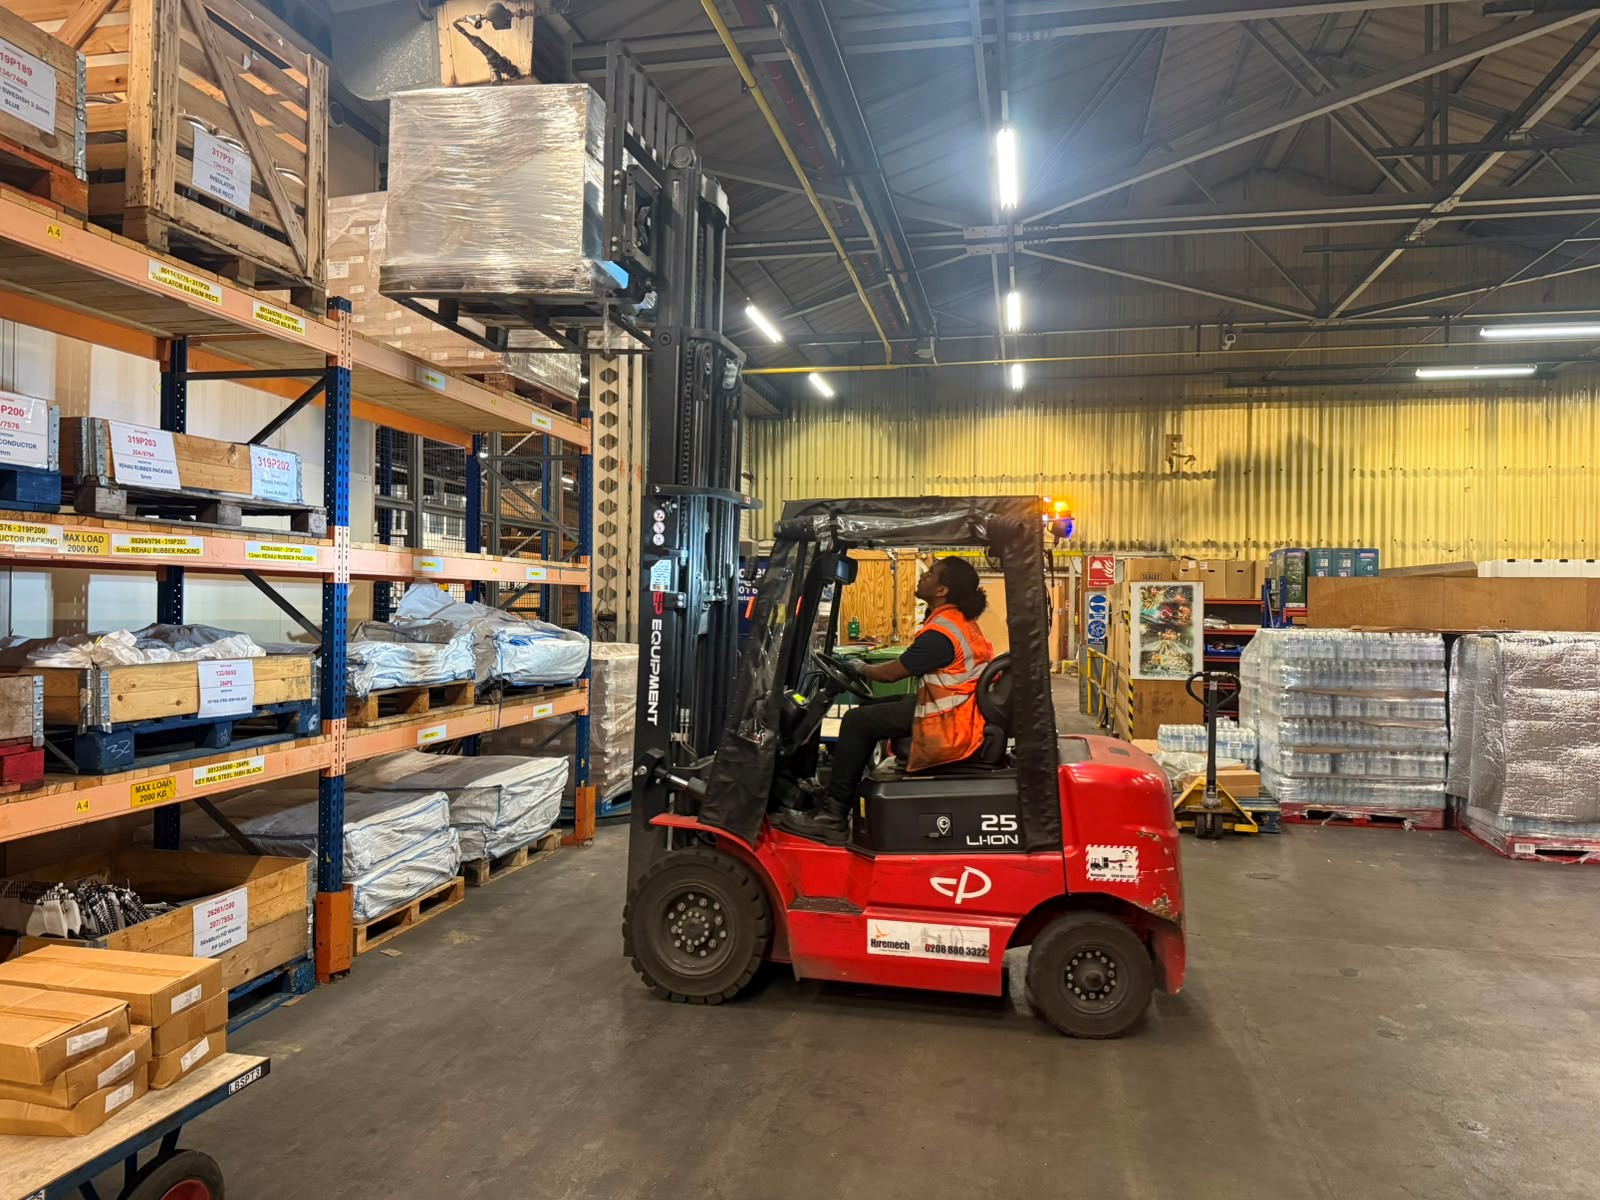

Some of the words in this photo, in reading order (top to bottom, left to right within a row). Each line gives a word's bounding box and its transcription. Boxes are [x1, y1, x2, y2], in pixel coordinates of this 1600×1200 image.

[4, 98, 20, 110] BLUE
[209, 174, 236, 192] INSULATOR
[128, 435, 157, 448] 319P203
[257, 456, 290, 471] 319P202
[17, 525, 46, 534] 319P200
[27, 536, 58, 545] PACKING
[63, 533, 80, 542] MAX
[82, 534, 105, 544] LOAD
[68, 544, 86, 553] 2000
[87, 545, 99, 554] KG
[647, 618, 662, 726] EQUIPMENT
[135, 784, 151, 793] MAX
[152, 780, 172, 790] LOAD
[140, 792, 155, 802] 2000
[157, 790, 167, 799] KG
[980, 814, 1018, 831] 25
[871, 938, 910, 950] Hiremech
[924, 943, 946, 954] 0208
[948, 945, 964, 956] 880
[230, 1068, 260, 1094] LBSPT3
